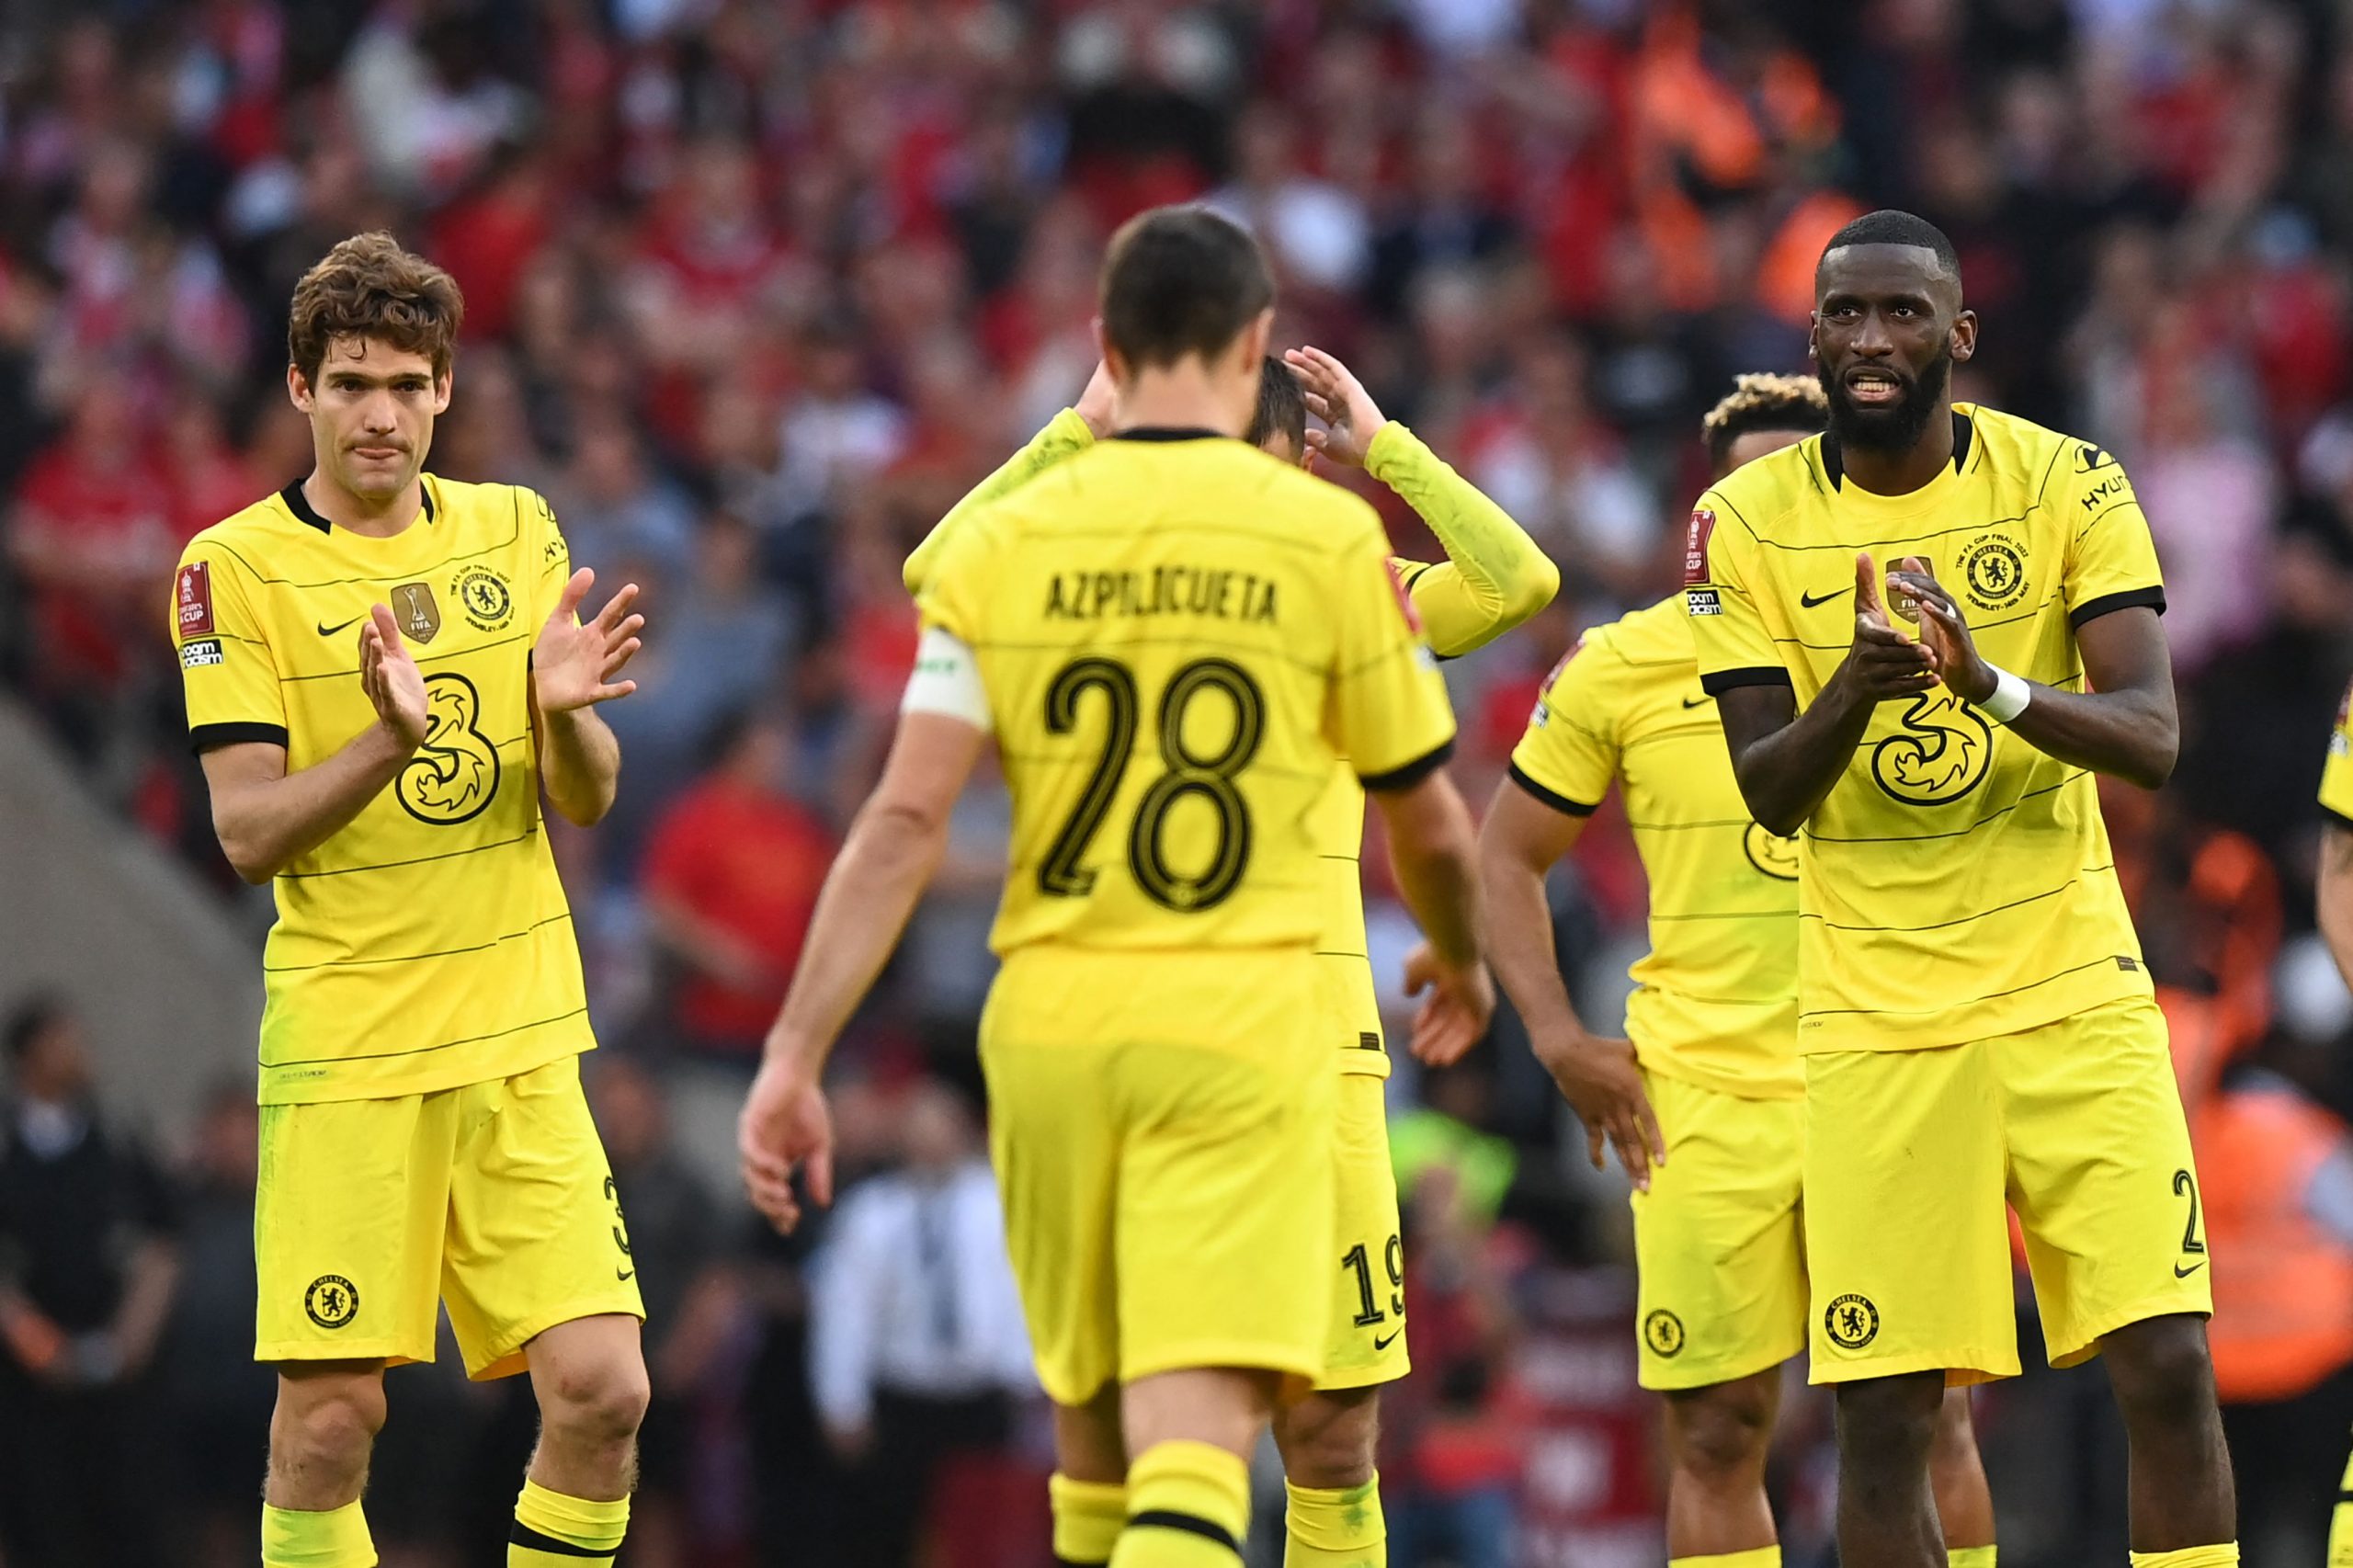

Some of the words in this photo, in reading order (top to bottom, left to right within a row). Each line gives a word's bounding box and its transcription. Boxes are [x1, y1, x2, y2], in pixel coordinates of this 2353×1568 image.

[1973, 534, 1989, 544] CUP
[1972, 545, 2008, 561] CHELSEA
[1044, 565, 1278, 623] AZPILICUETA
[1902, 598, 1920, 608] FIF
[410, 619, 432, 631] FIFA
[1037, 656, 1265, 914] 28
[2172, 1168, 2205, 1255] 2
[313, 1276, 349, 1289] CHELSEA
[1341, 1233, 1405, 1329] 19
[1831, 1295, 1868, 1309] CHELSEA
